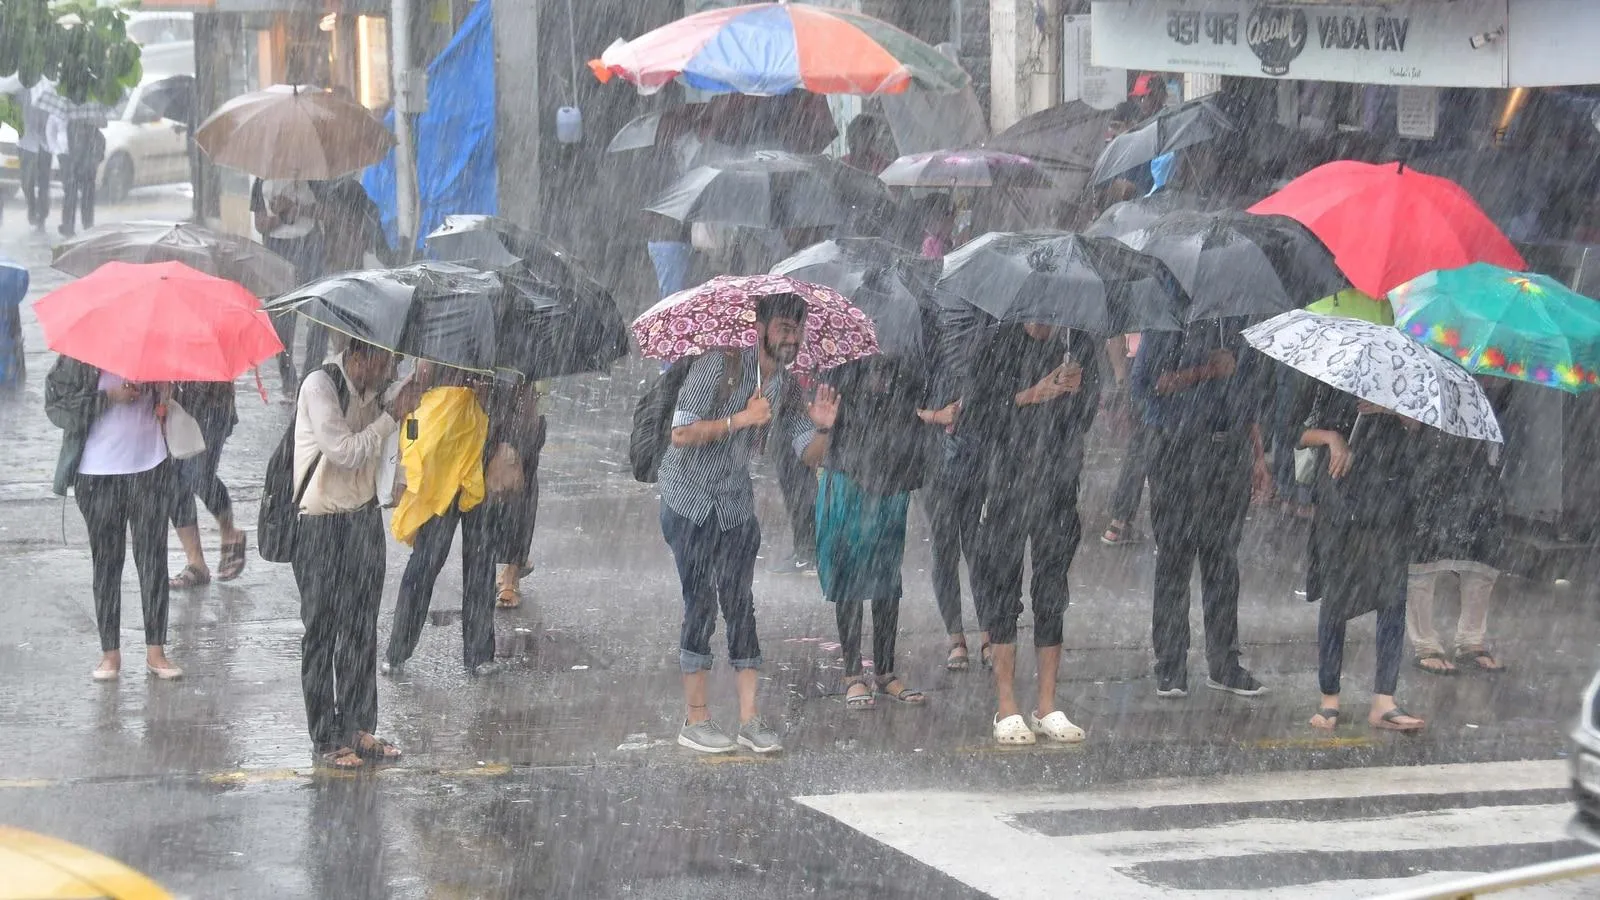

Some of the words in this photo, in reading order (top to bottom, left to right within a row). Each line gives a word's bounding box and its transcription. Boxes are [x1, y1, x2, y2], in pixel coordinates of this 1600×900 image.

[1166, 9, 1200, 46] वडा
[1204, 11, 1239, 46] पाव
[1316, 15, 1370, 50] VADA
[1375, 16, 1409, 52] PAV
